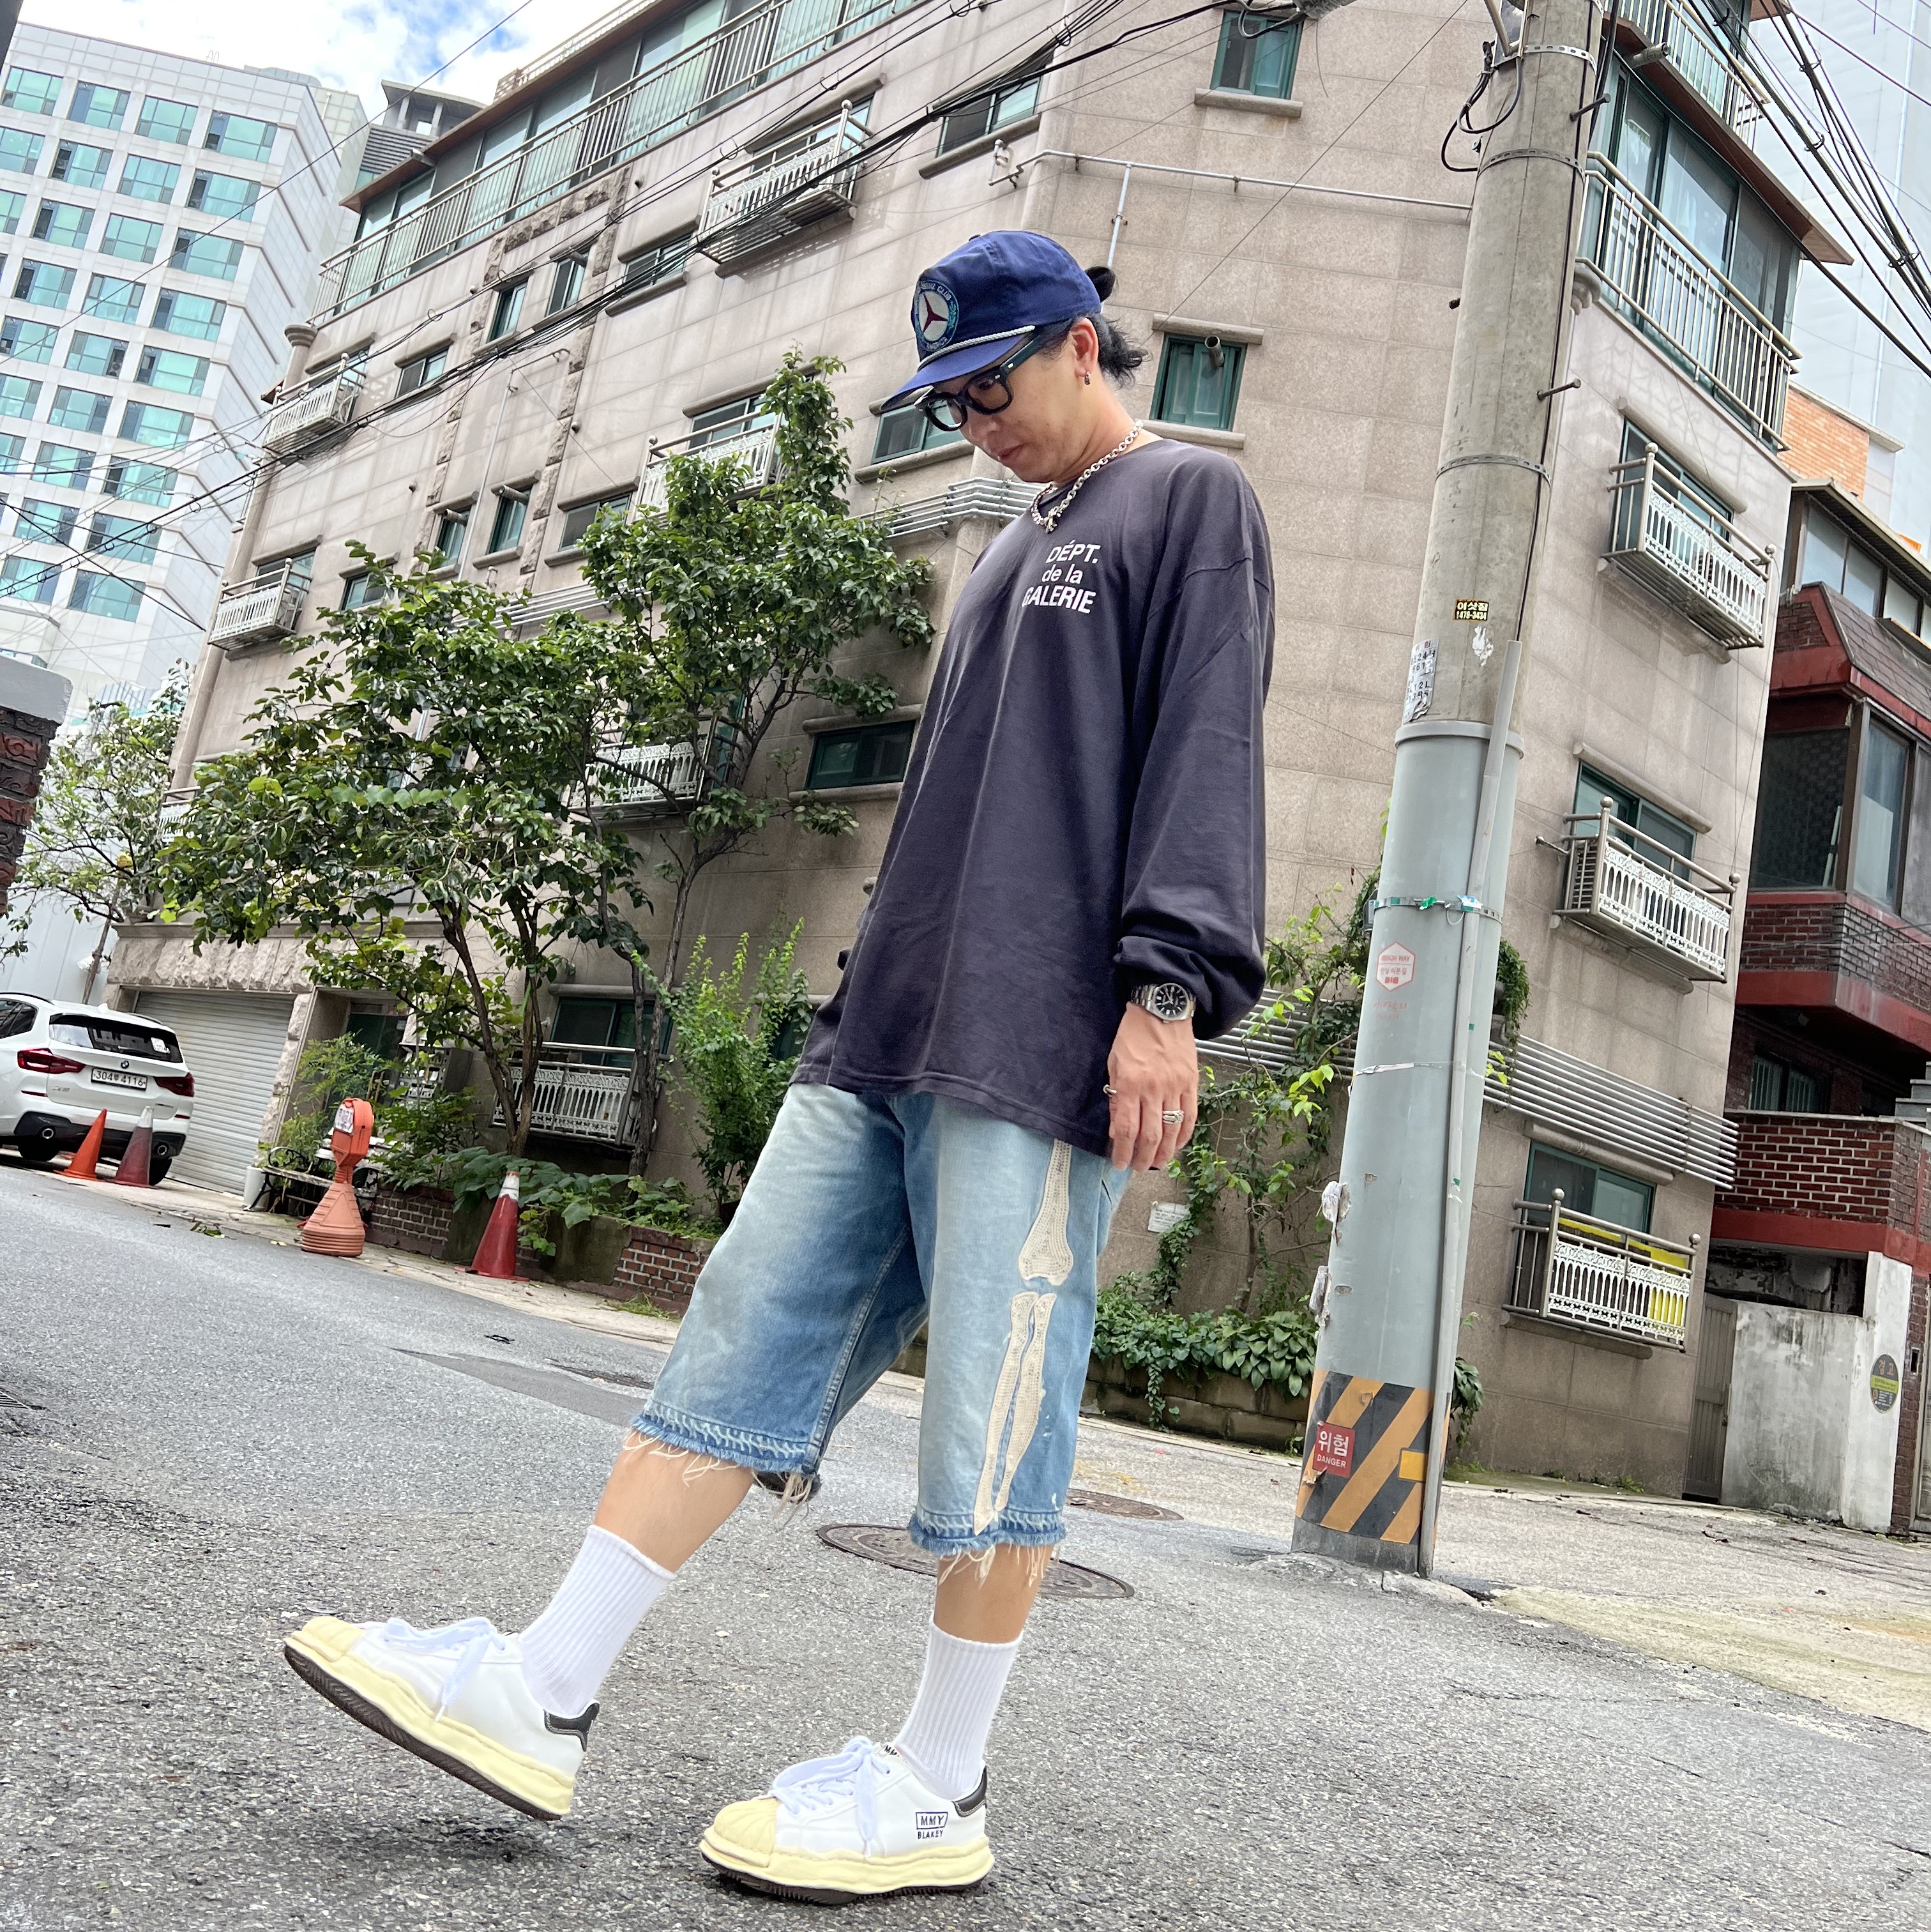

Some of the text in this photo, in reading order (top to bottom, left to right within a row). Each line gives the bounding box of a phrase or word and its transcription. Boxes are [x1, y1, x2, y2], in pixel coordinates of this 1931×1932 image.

[1045, 539, 1101, 564] DÉPT.
[1041, 563, 1083, 584] de la
[1021, 584, 1096, 614] GALERIE
[1457, 602, 1488, 611] 이삿짐
[1318, 1431, 1349, 1457] 위험
[1317, 1454, 1347, 1468] DANGER
[920, 1815, 944, 1826] MMY
[918, 1830, 944, 1839] BLAKEY
